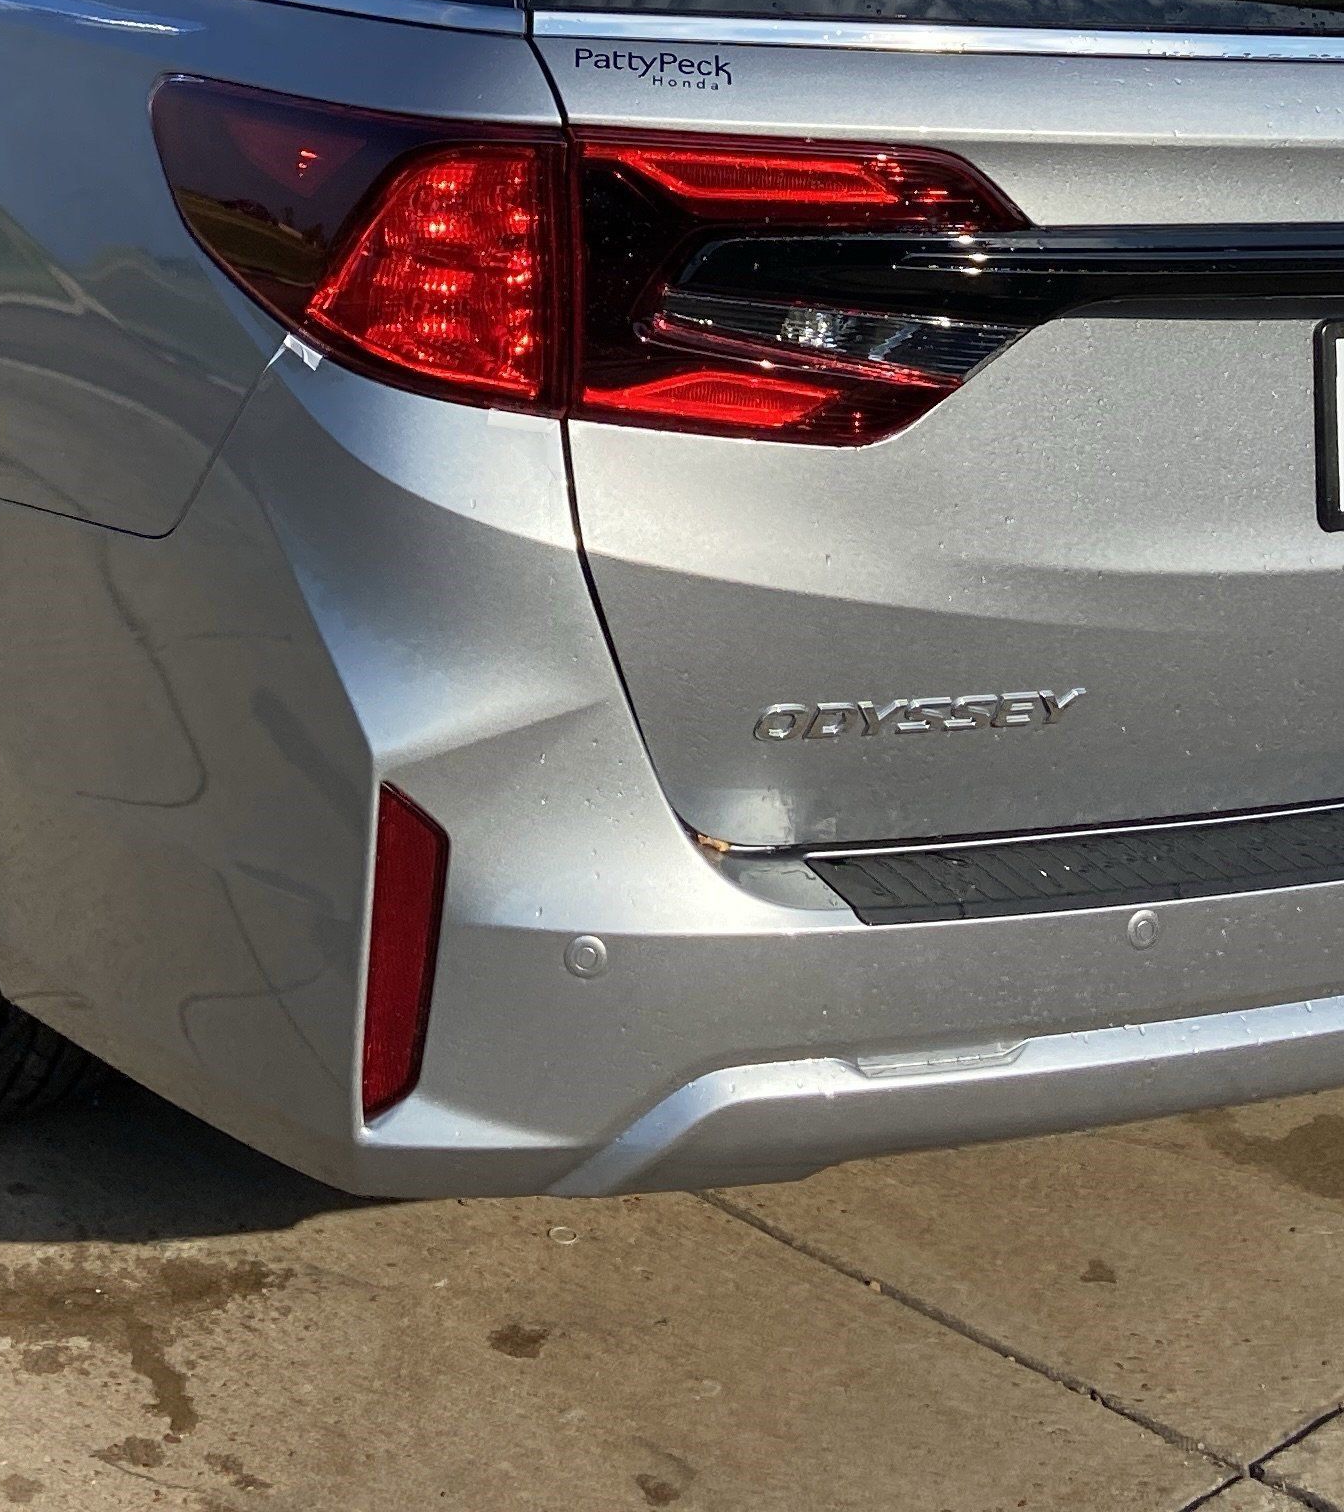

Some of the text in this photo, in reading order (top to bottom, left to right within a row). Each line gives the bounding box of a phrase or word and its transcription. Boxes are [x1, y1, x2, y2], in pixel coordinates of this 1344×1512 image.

[575, 48, 732, 85] PattyPeck
[652, 75, 719, 90] Honda
[753, 687, 1087, 740] ODYSSEY
